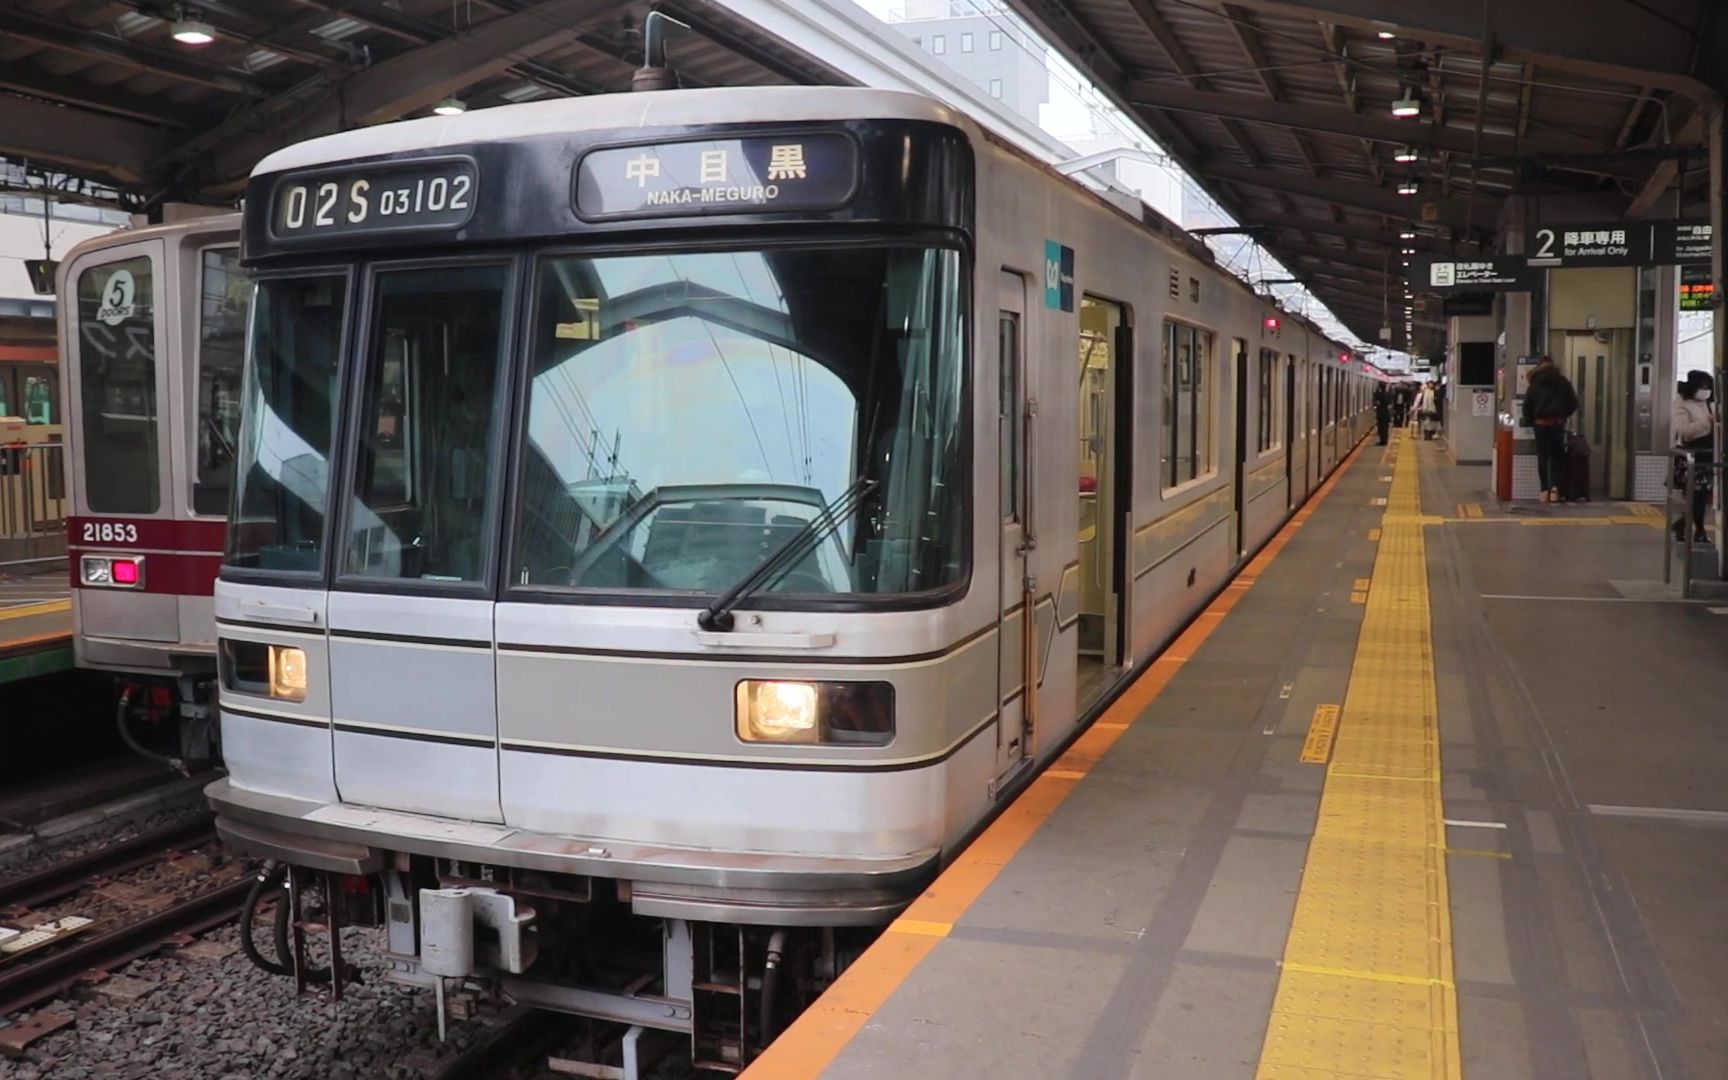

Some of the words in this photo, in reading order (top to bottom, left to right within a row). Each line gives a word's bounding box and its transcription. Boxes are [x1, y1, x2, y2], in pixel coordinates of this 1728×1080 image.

[625, 143, 808, 188] 中目黒
[647, 184, 780, 207] NAKA-MEGURO
[1536, 229, 1555, 257] 2
[1564, 230, 1625, 245] 降車専用
[1564, 248, 1576, 256] for
[1577, 247, 1606, 256] Arrival
[1607, 246, 1629, 257] Only
[109, 280, 126, 307] 5
[101, 305, 131, 318] DOORS
[83, 522, 138, 543] 21853
